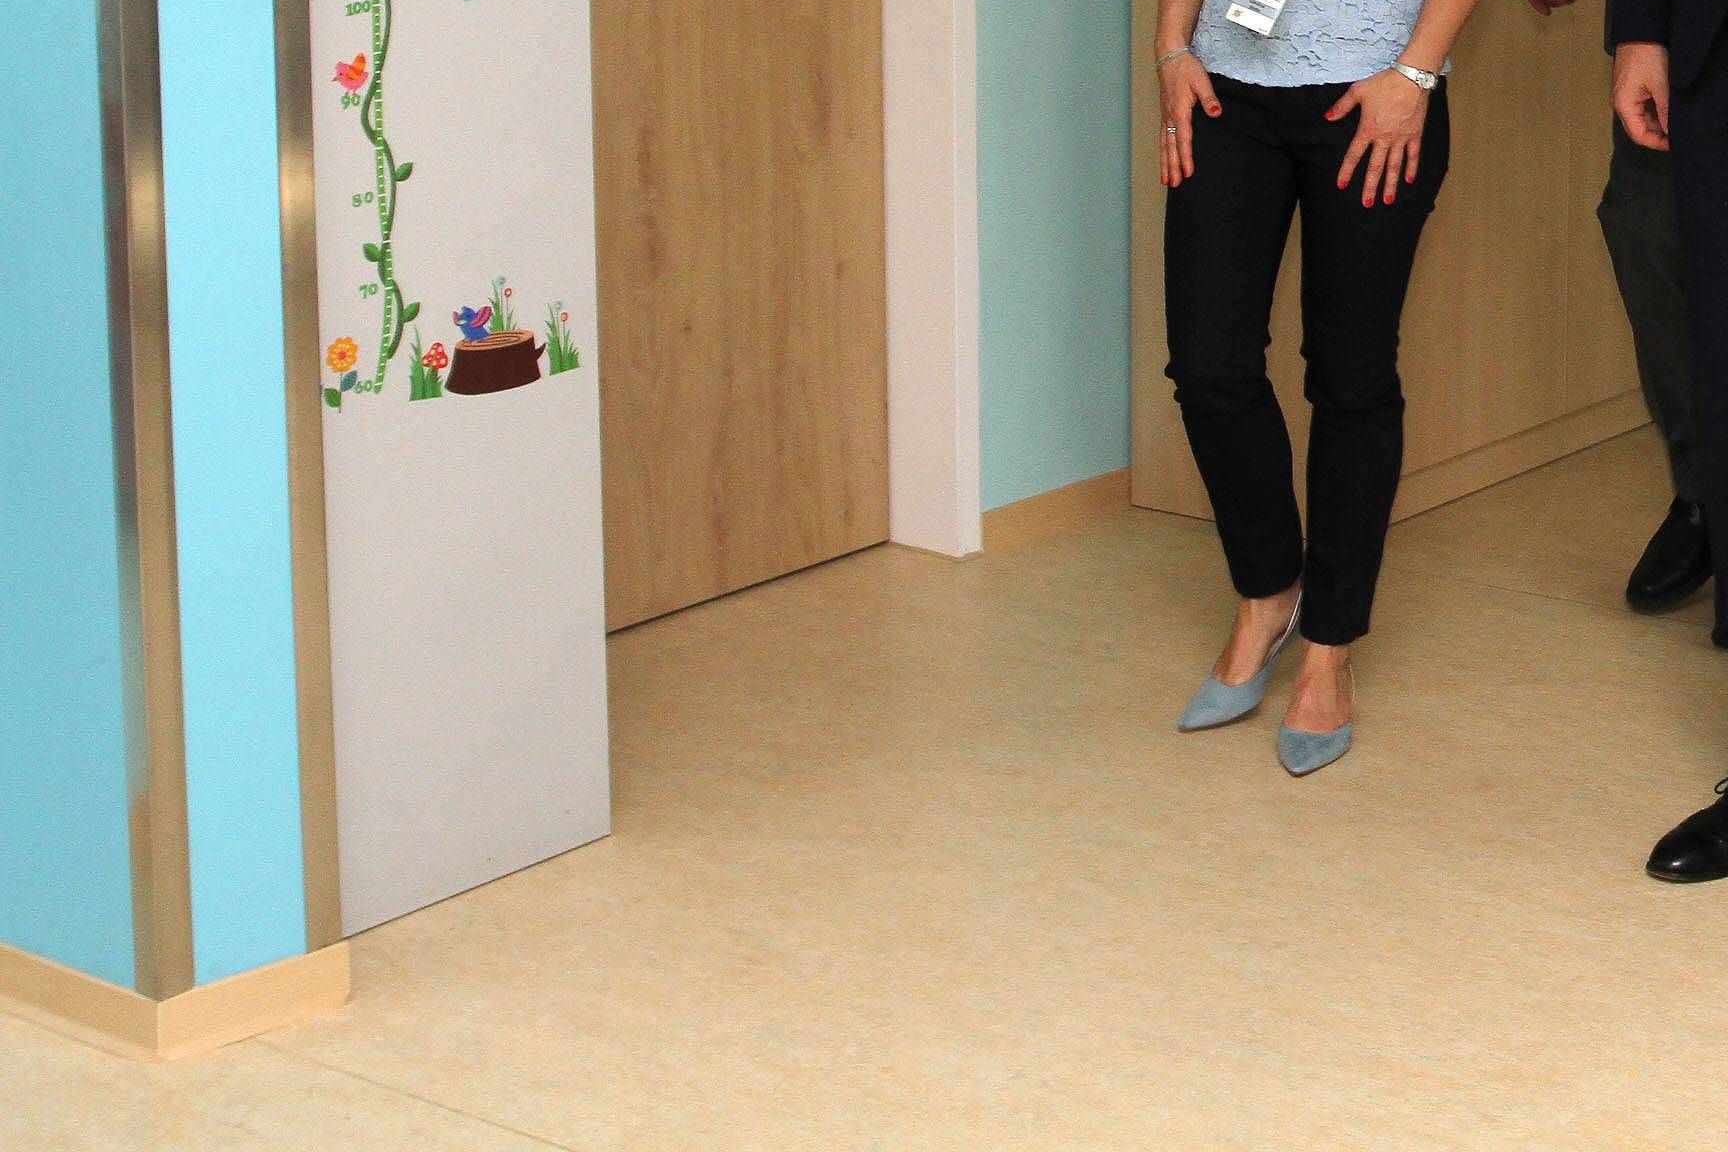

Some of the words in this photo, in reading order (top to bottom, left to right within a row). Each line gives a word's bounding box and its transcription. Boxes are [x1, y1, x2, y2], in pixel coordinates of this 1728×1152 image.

[345, 0, 371, 16] 100
[340, 95, 361, 109] 90
[352, 191, 374, 208] 80
[359, 283, 378, 298] 70
[354, 380, 373, 394] 60
